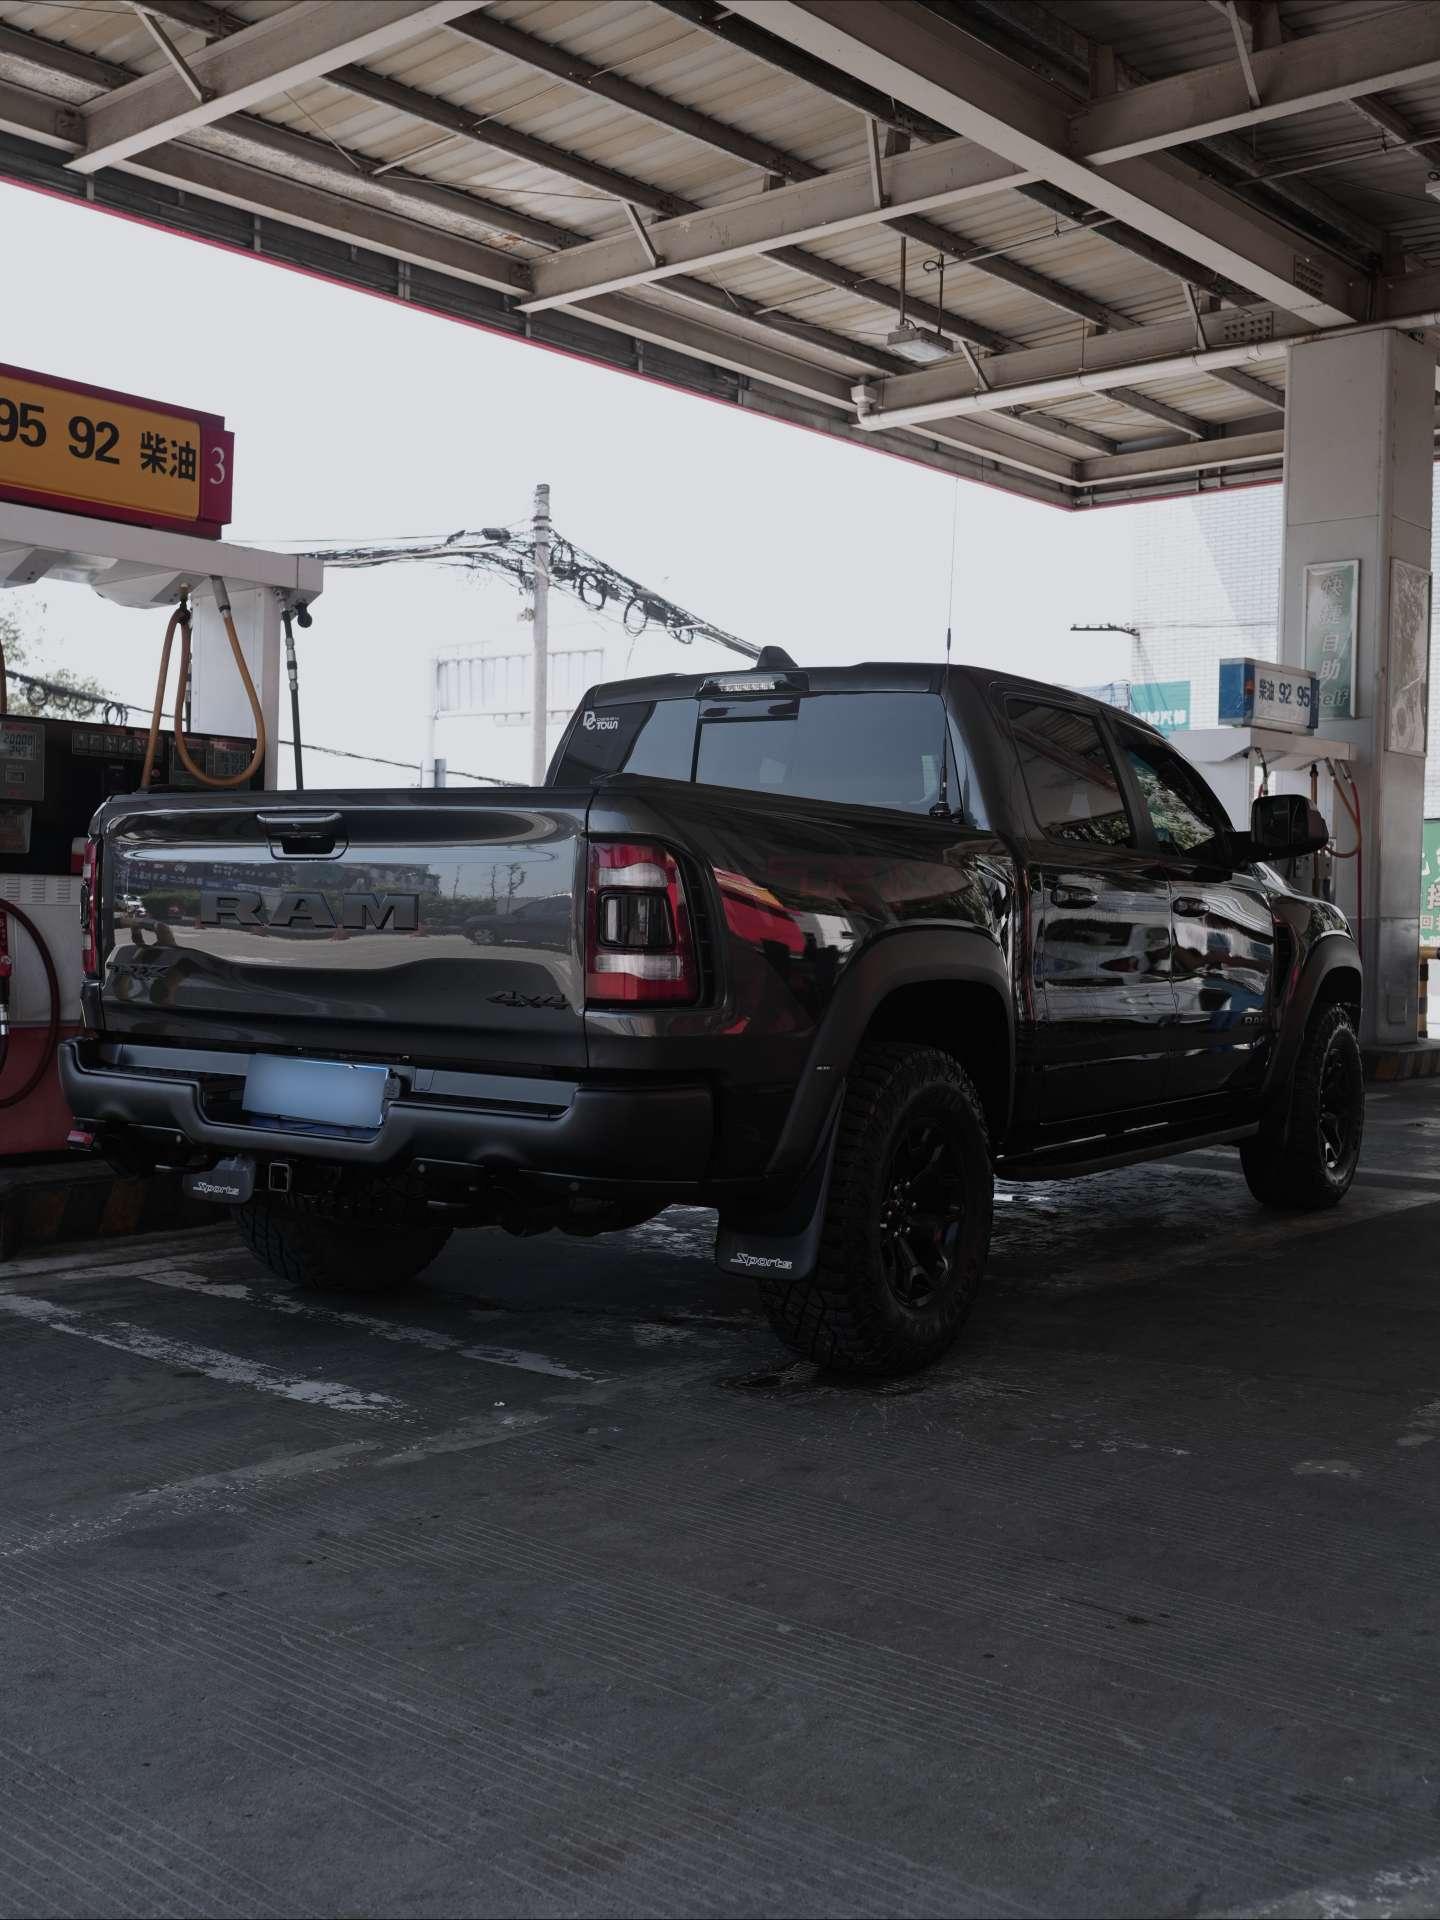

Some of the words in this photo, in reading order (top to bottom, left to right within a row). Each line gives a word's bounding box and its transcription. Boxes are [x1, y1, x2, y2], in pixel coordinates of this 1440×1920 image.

[0, 397, 47, 447] 95
[68, 415, 120, 465] 92
[140, 431, 197, 482] 柴油
[209, 446, 226, 485] 3
[1258, 679, 1275, 701] 柴油
[1278, 682, 1292, 704] 92
[1297, 686, 1310, 707] 95
[200, 891, 419, 931] RAM
[192, 1181, 240, 1196] Sports
[729, 1252, 793, 1270] Sports
